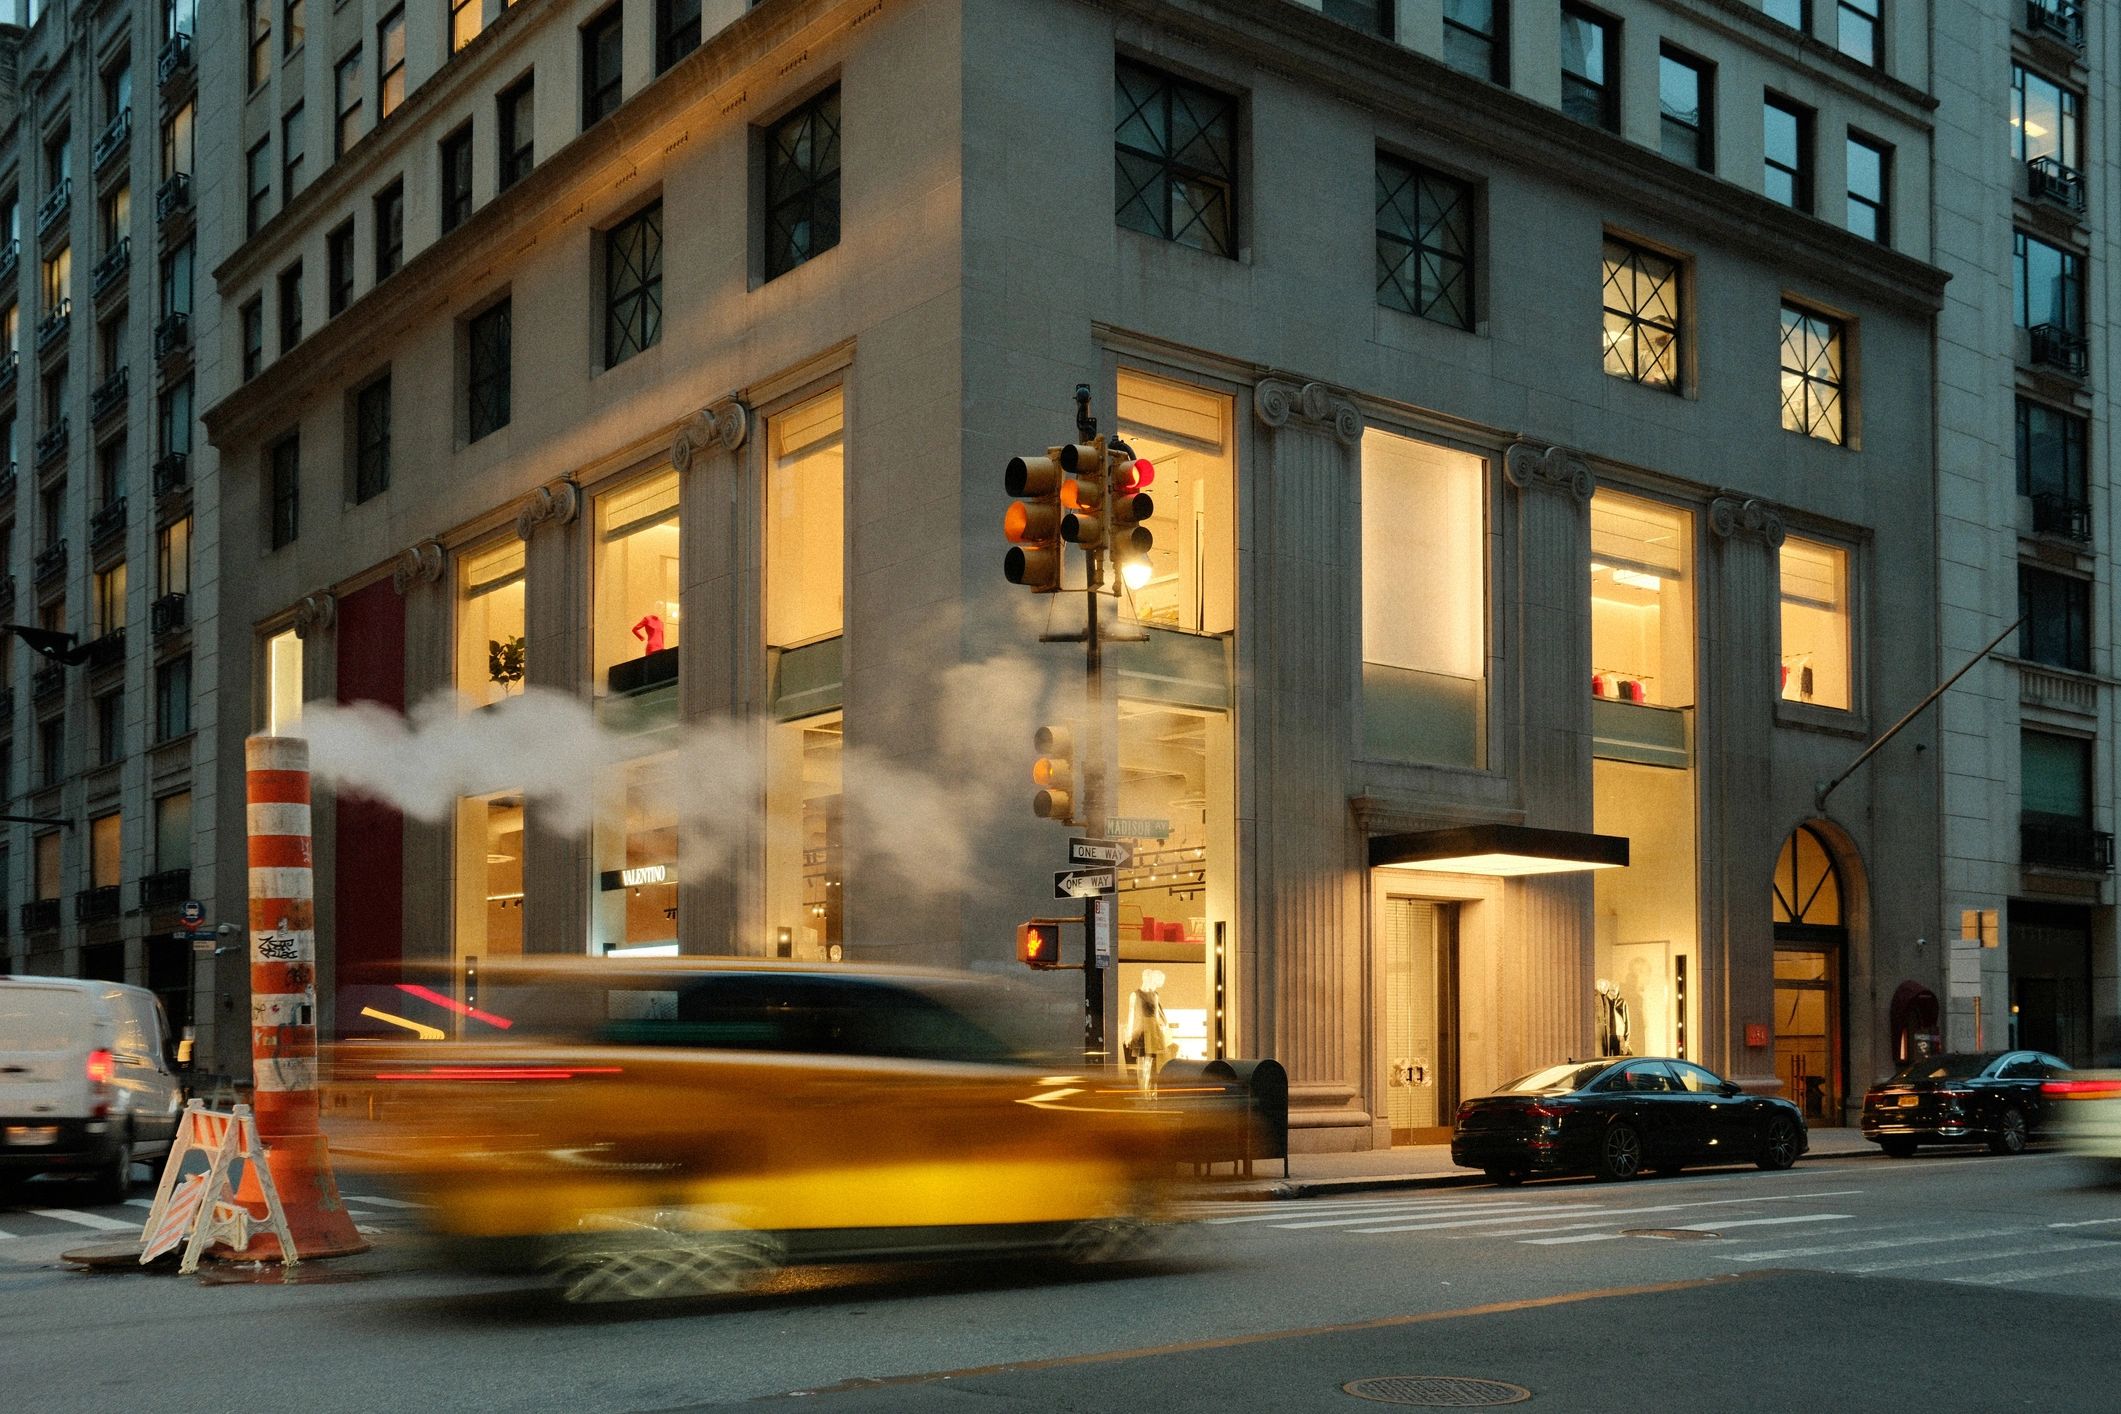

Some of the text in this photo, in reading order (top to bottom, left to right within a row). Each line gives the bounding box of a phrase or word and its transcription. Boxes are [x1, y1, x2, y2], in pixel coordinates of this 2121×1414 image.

[1107, 819, 1151, 836] MADISON
[1078, 846, 1123, 860] ONE WAY
[622, 865, 666, 886] VALENTINO
[1066, 876, 1109, 890] ONE WAY
